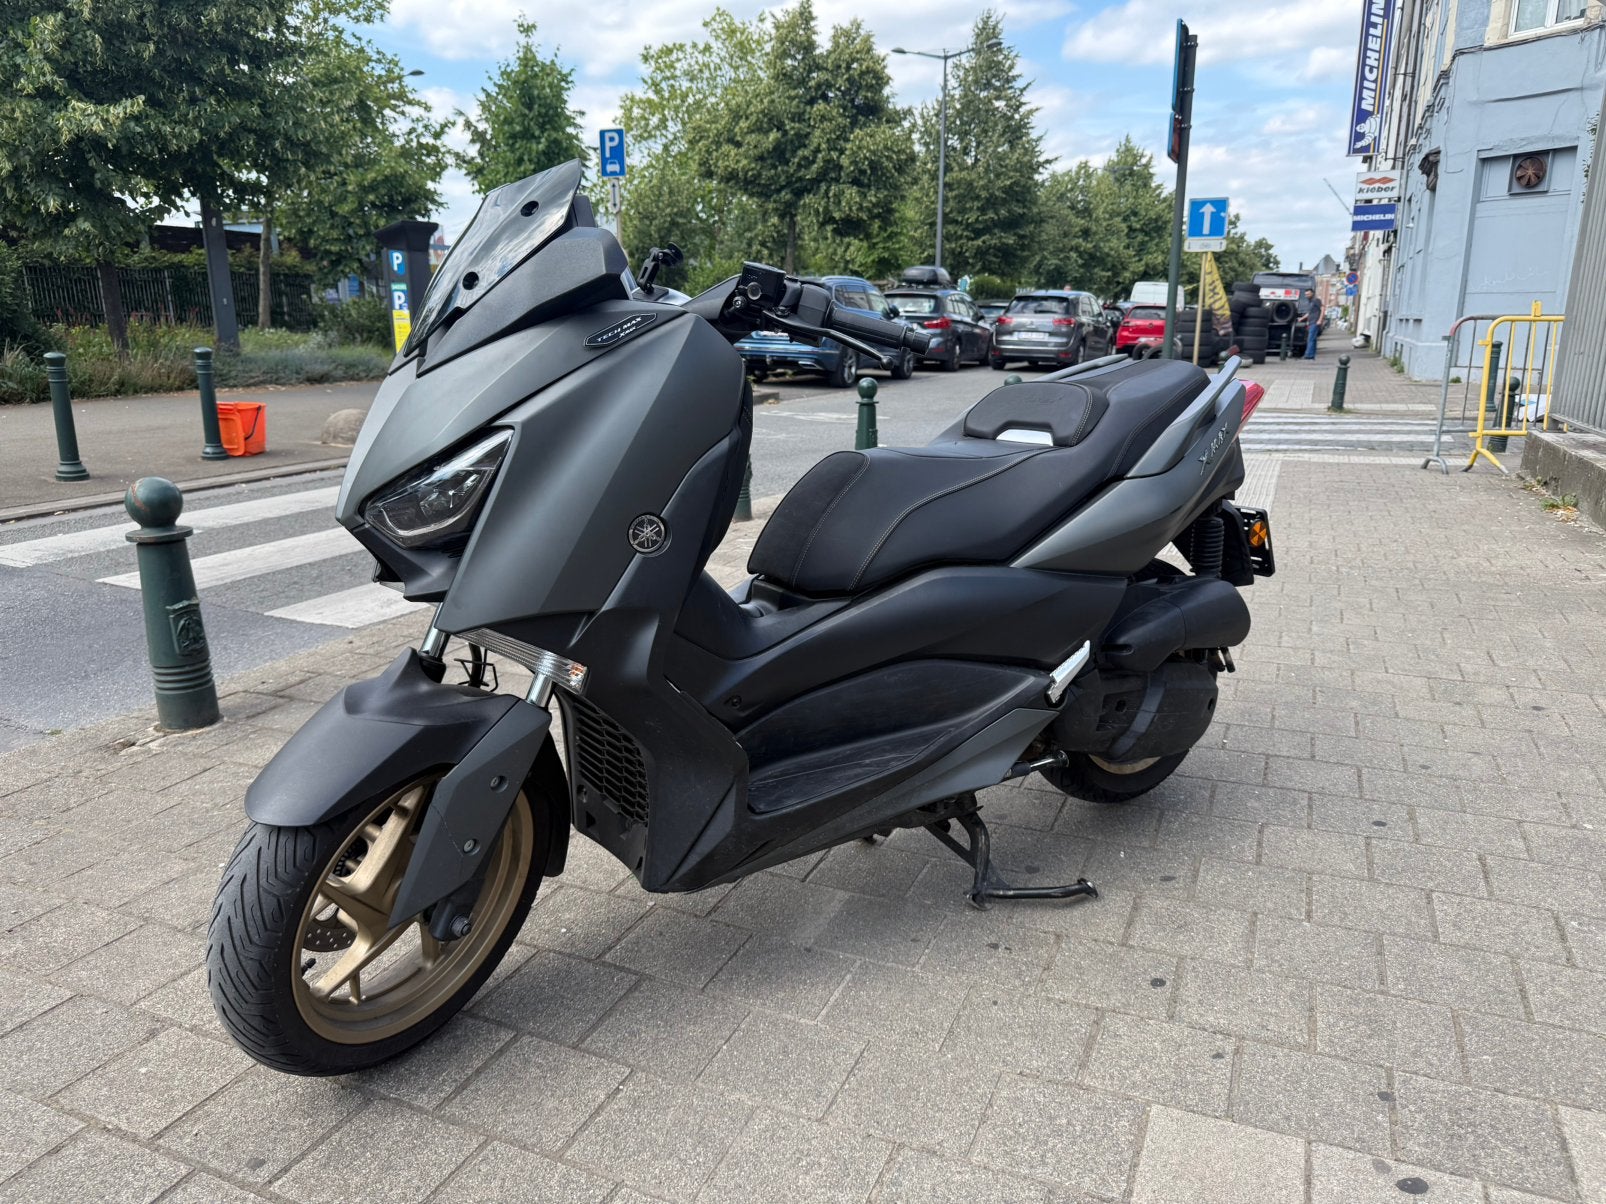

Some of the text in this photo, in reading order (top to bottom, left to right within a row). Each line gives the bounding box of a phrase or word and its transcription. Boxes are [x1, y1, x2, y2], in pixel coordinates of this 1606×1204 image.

[1361, 0, 1385, 112] MICHELIN
[604, 131, 619, 158] P
[1353, 213, 1394, 221] MICHELIN
[392, 252, 403, 271] P
[393, 291, 406, 310] P
